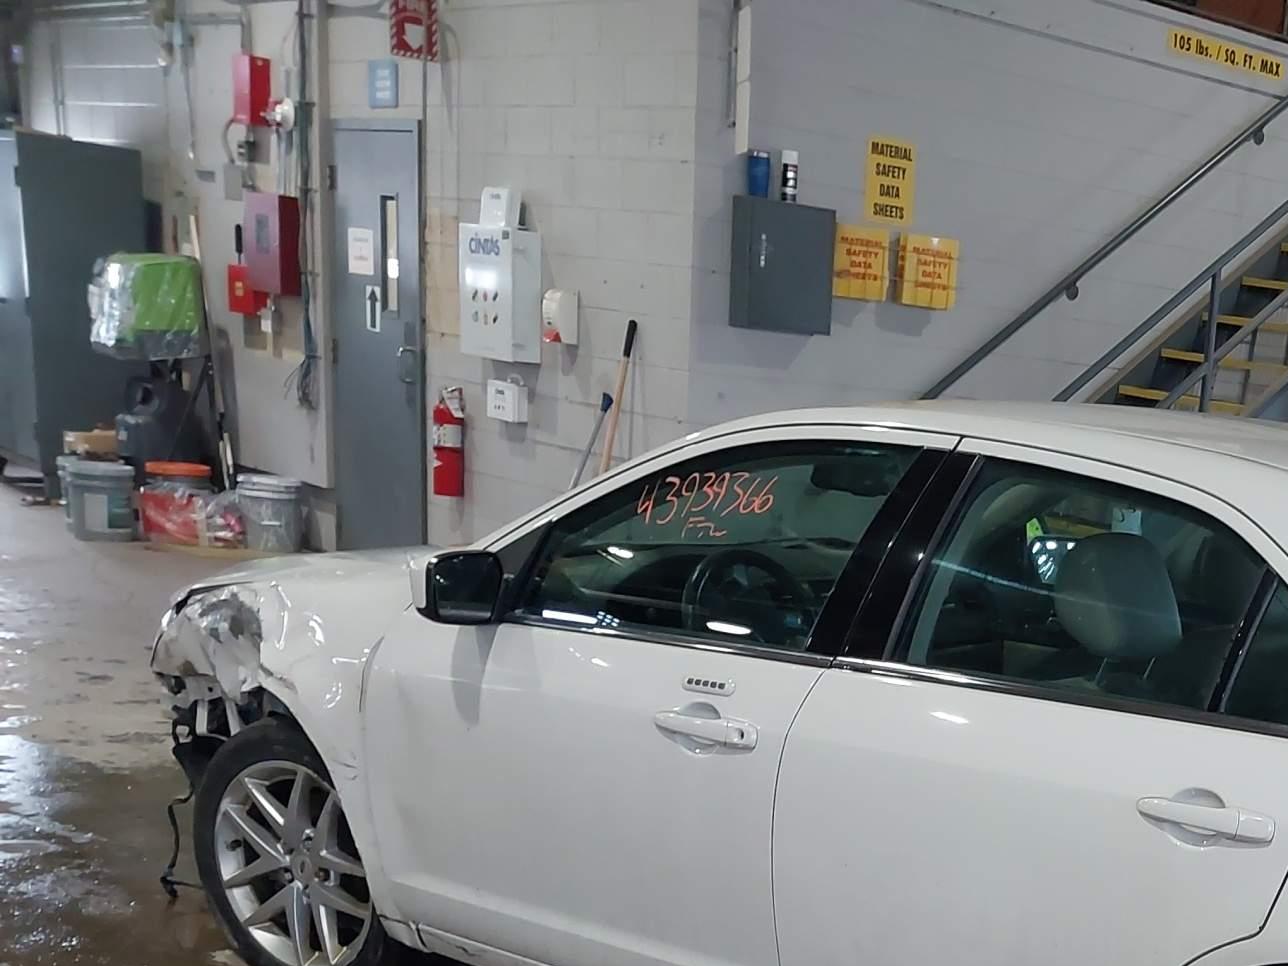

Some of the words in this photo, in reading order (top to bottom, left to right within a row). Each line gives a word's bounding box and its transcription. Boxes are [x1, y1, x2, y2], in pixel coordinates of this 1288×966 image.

[1173, 33, 1192, 52] 105
[1195, 38, 1212, 58] lbs.
[1216, 45, 1221, 60] /
[1224, 48, 1239, 66] SQ.
[1243, 53, 1256, 71] FT.
[1260, 58, 1281, 77] MAX
[871, 141, 913, 162] MATERIAL
[875, 162, 907, 181] SAFETY
[880, 183, 900, 199] DATA
[872, 202, 905, 220] SHEETS
[846, 247, 879, 259] SAFETY
[850, 260, 873, 270] DATA
[917, 258, 948, 270] SAFETY
[922, 270, 943, 280] DATA
[636, 472, 778, 525] 43939366
